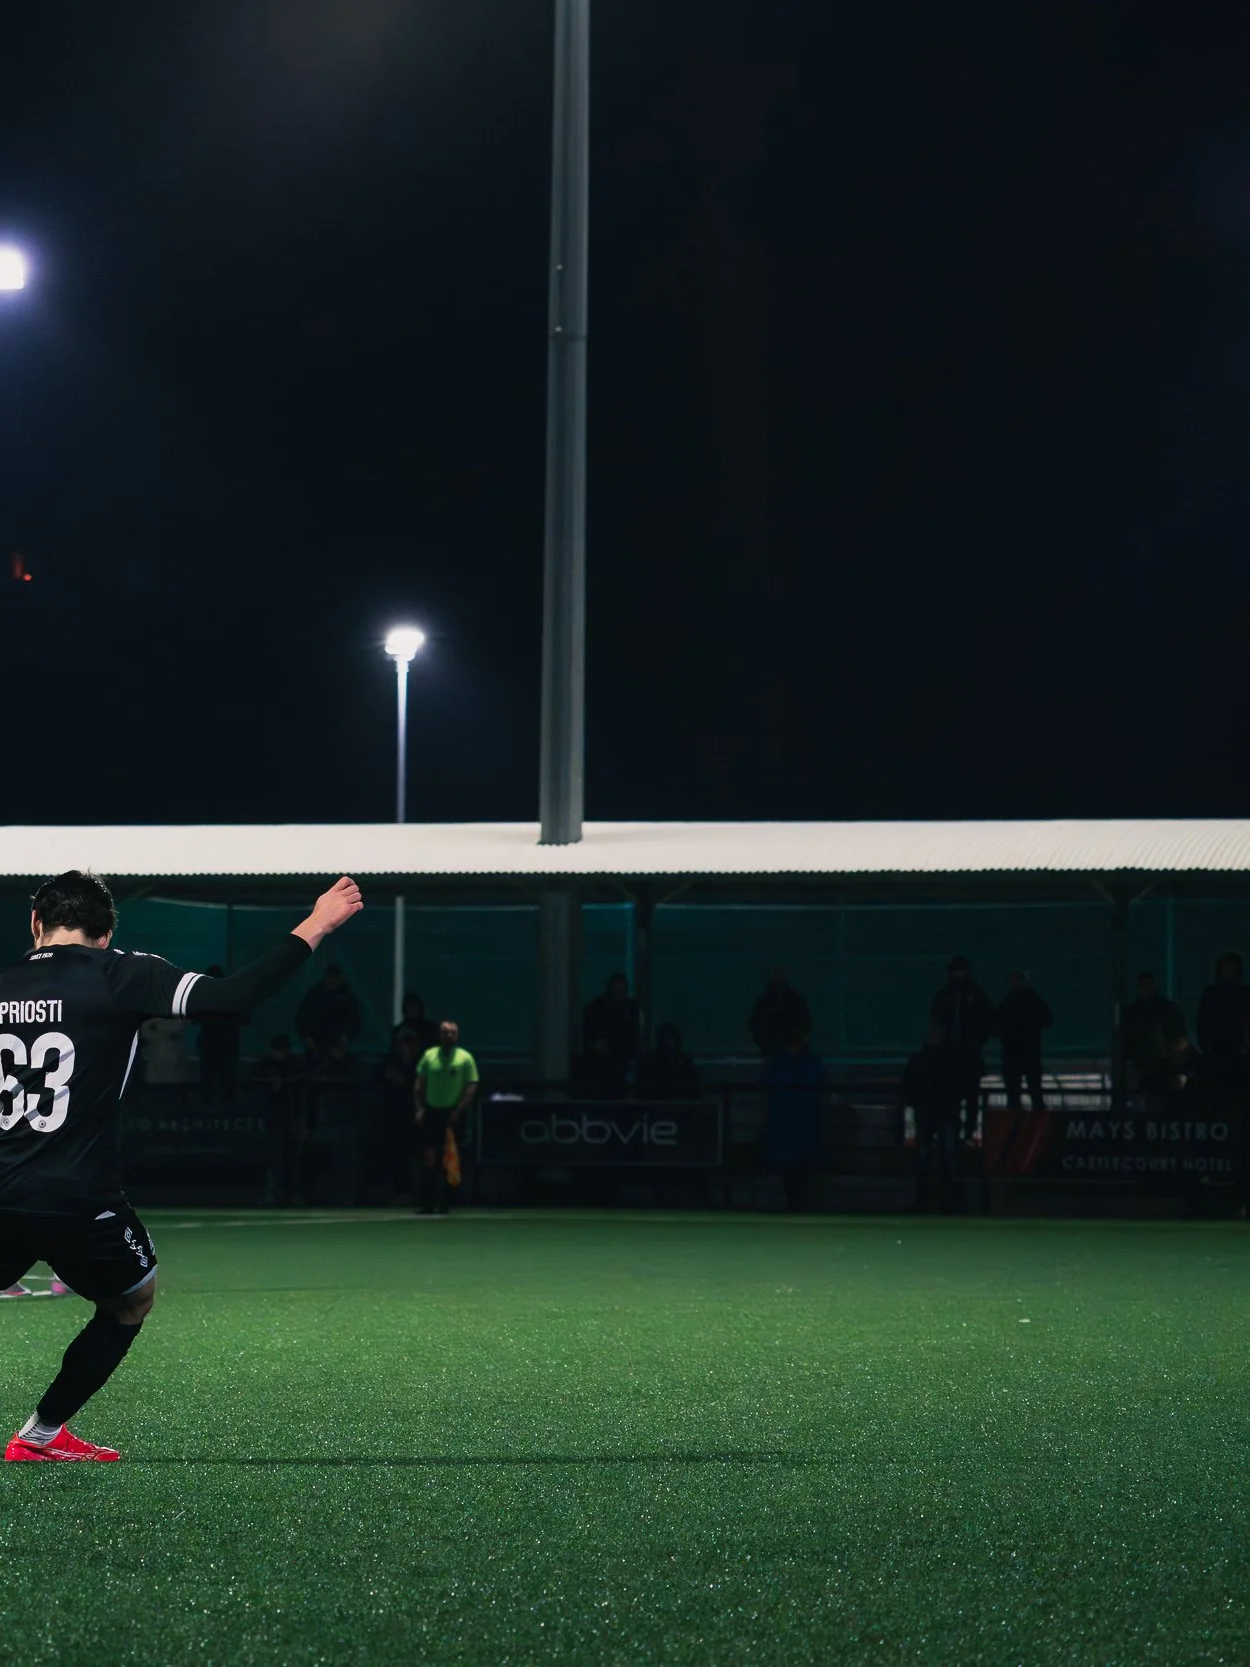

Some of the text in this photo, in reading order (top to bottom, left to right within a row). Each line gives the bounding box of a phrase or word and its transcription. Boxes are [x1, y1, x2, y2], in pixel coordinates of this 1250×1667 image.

[0, 1000, 62, 1024] PRIOSTI
[519, 1113, 679, 1146] abbvie
[1066, 1120, 1229, 1142] MAYS BISTRO
[1182, 1156, 1234, 1173] HOTEL
